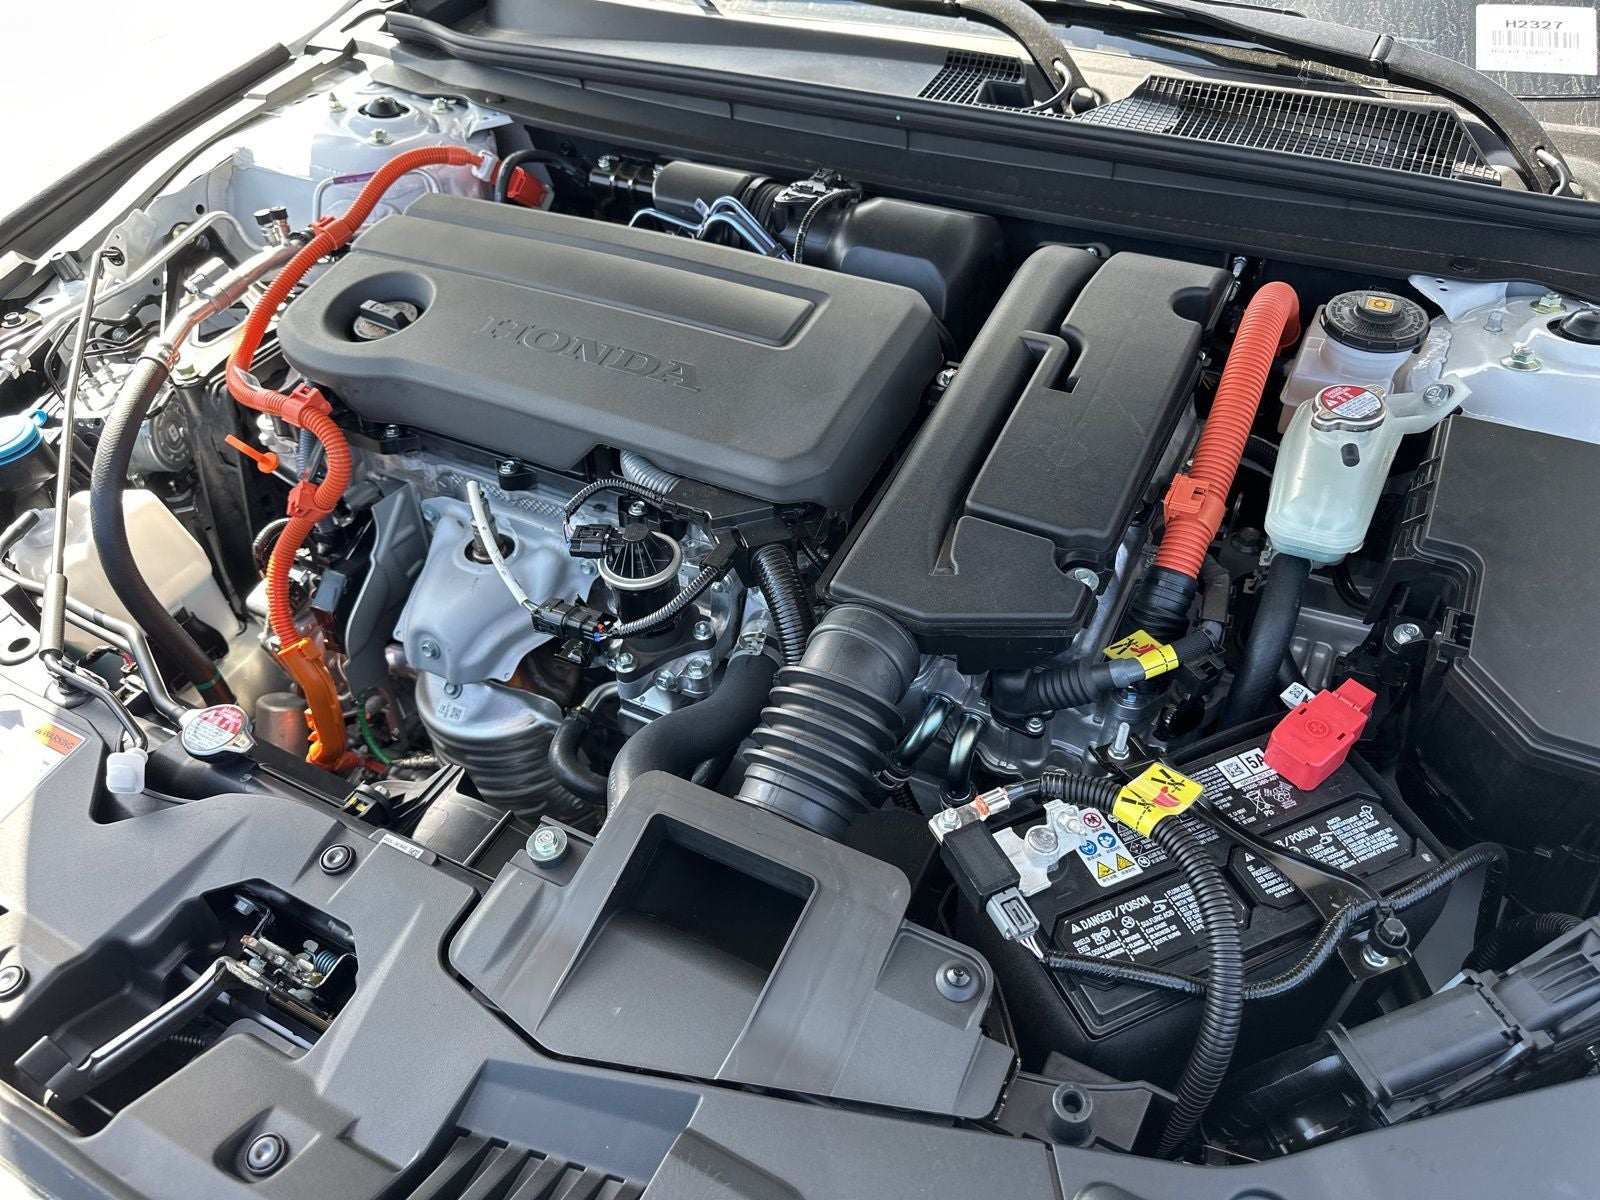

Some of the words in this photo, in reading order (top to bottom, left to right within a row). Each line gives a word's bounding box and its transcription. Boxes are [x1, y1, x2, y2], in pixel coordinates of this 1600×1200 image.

[1506, 20, 1563, 29] H2327
[472, 316, 701, 392] HONDA
[43, 730, 74, 749] WARNING
